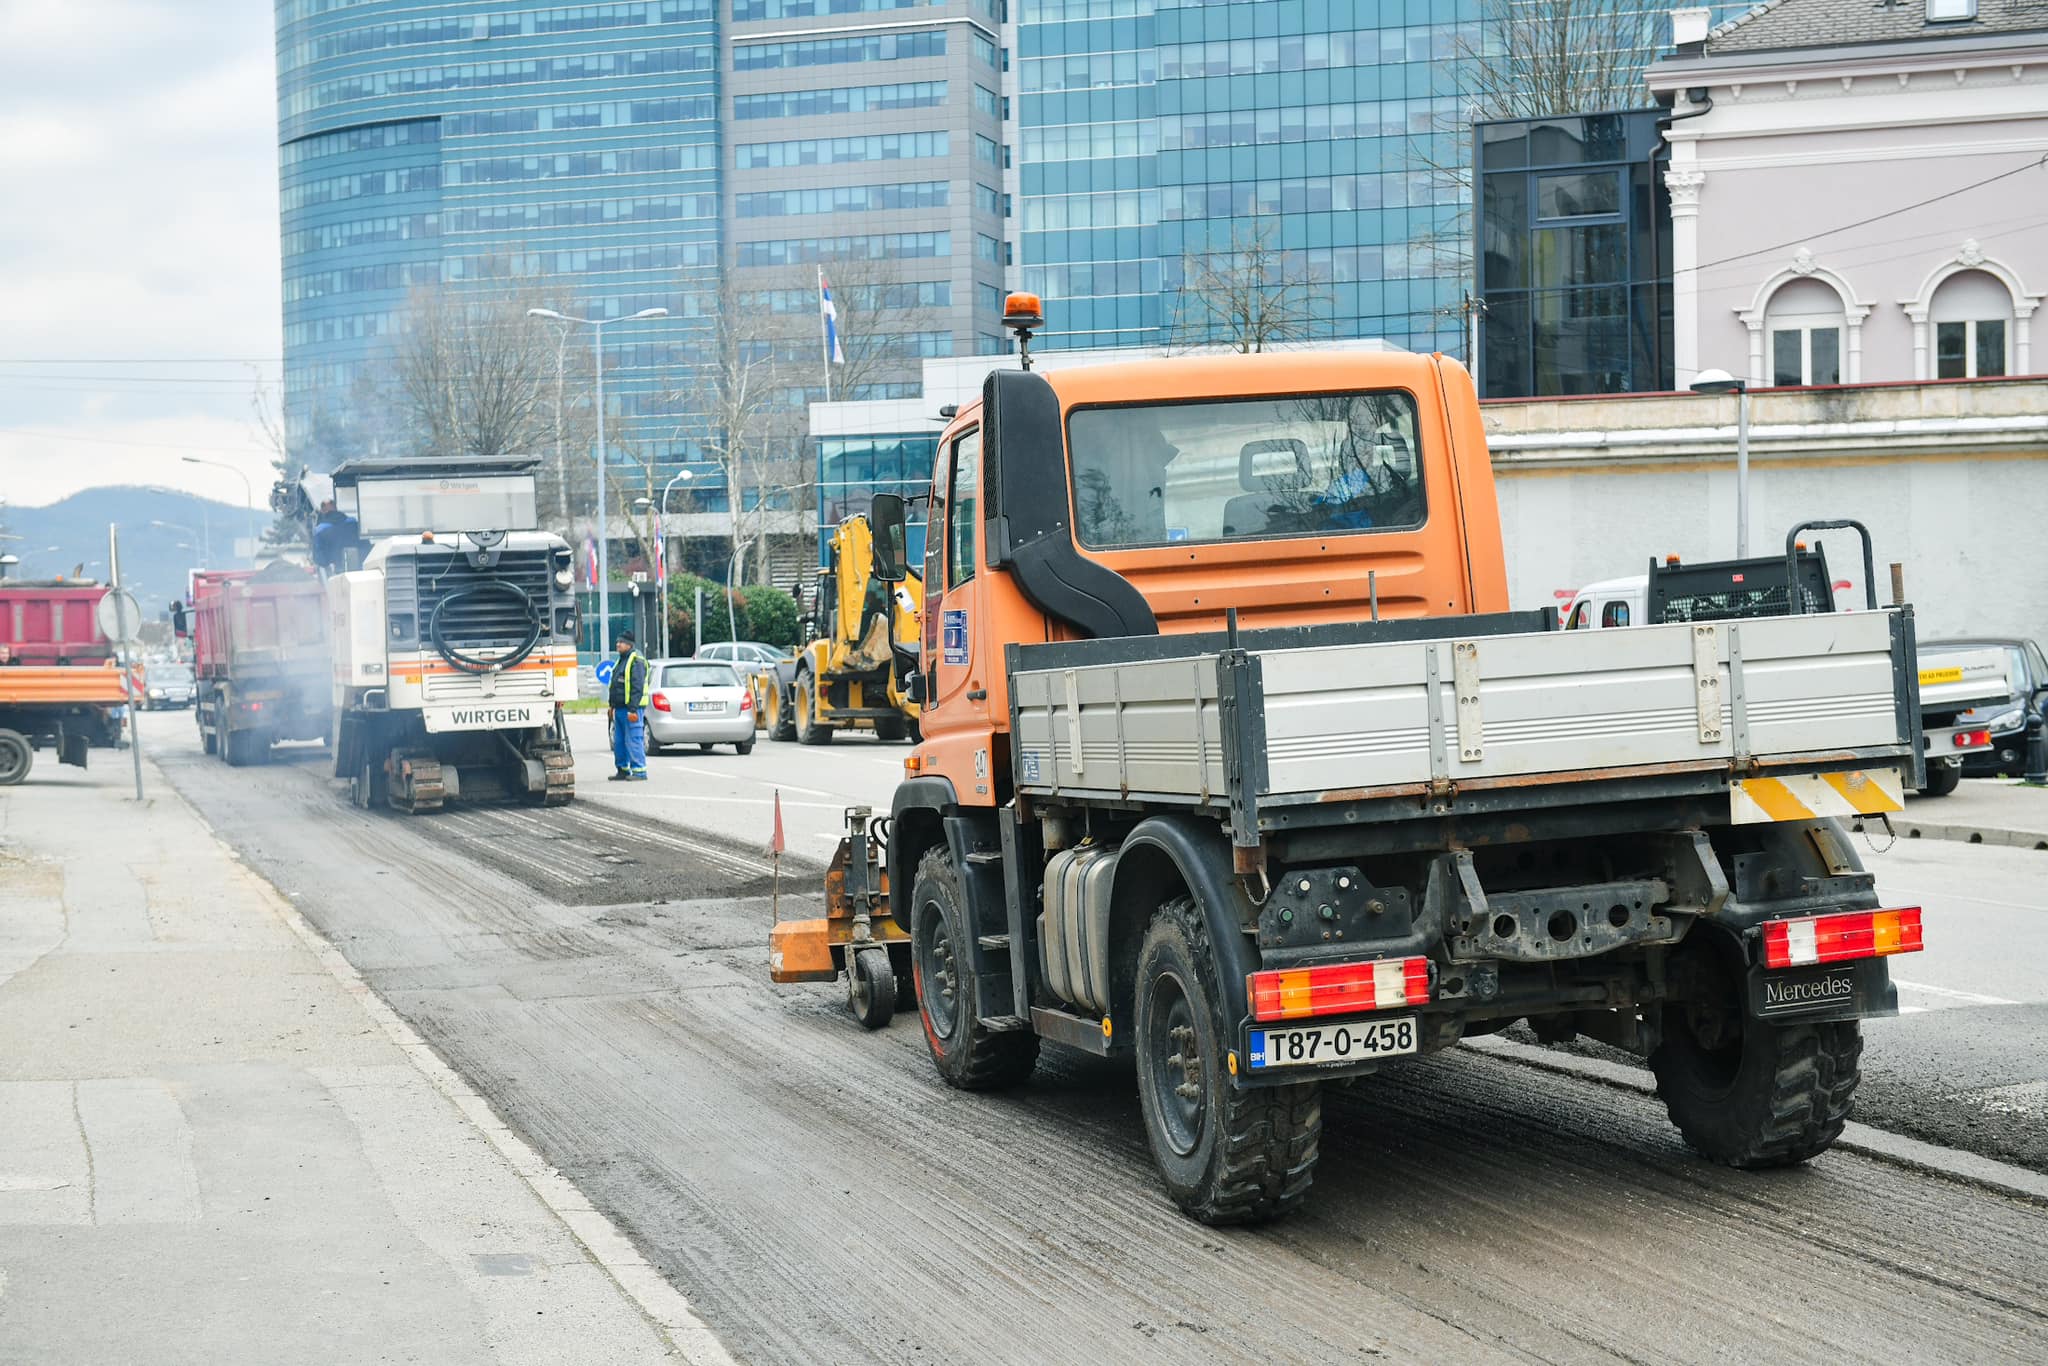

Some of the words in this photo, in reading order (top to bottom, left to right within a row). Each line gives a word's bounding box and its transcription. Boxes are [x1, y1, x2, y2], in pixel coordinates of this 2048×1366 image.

[452, 708, 530, 724] WIRTGEN
[1765, 976, 1851, 1003] Mercedes
[1250, 1052, 1265, 1062] BIH
